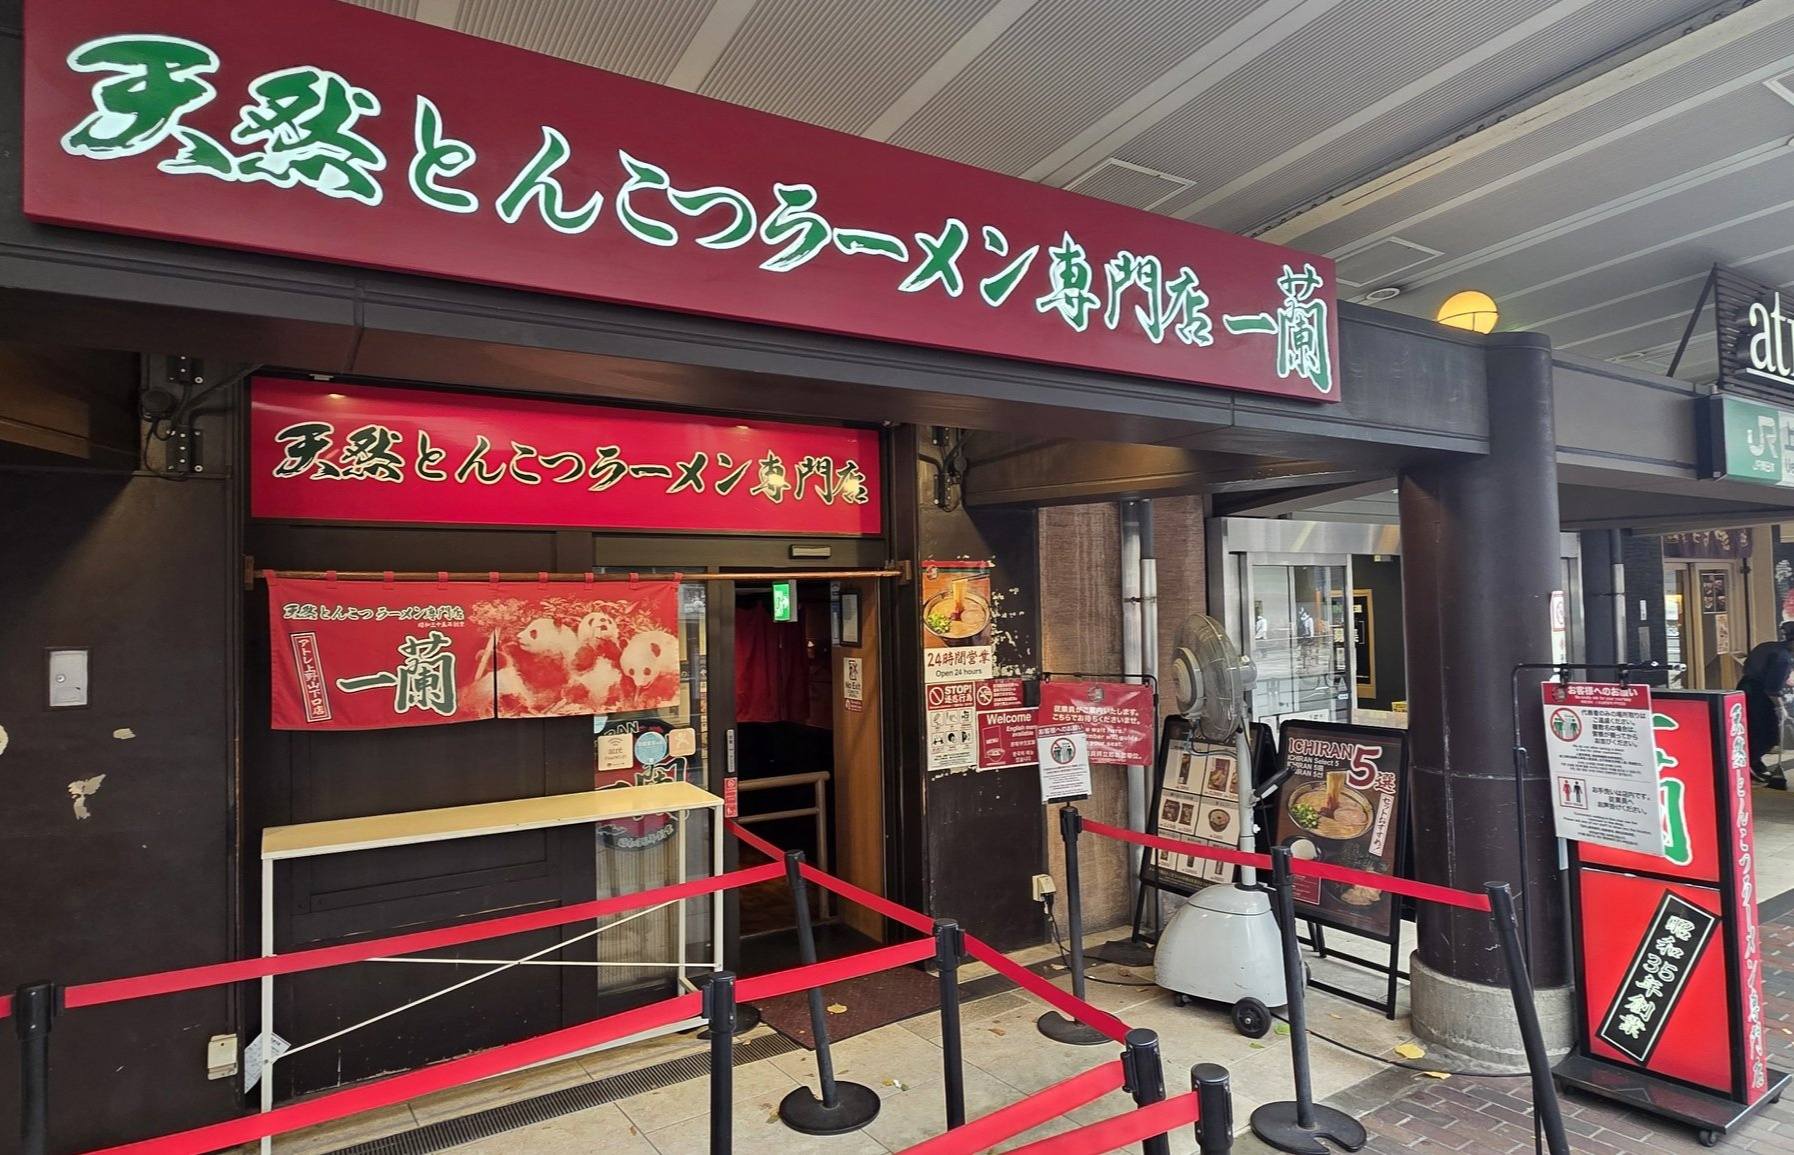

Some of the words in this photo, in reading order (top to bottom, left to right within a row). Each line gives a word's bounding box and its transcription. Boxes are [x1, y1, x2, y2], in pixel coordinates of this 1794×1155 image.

[272, 420, 870, 506] 天然とんこつラーメン専門店
[282, 603, 465, 622] 天然とんこつラーメン専門店
[927, 649, 991, 668] 24時間営業
[336, 630, 457, 717] 一蘭
[935, 669, 954, 678] Open
[954, 668, 962, 676] 24
[963, 668, 982, 676] hours
[986, 712, 1032, 725] Welcome
[1617, 914, 1697, 1040] 昭和35年創業
